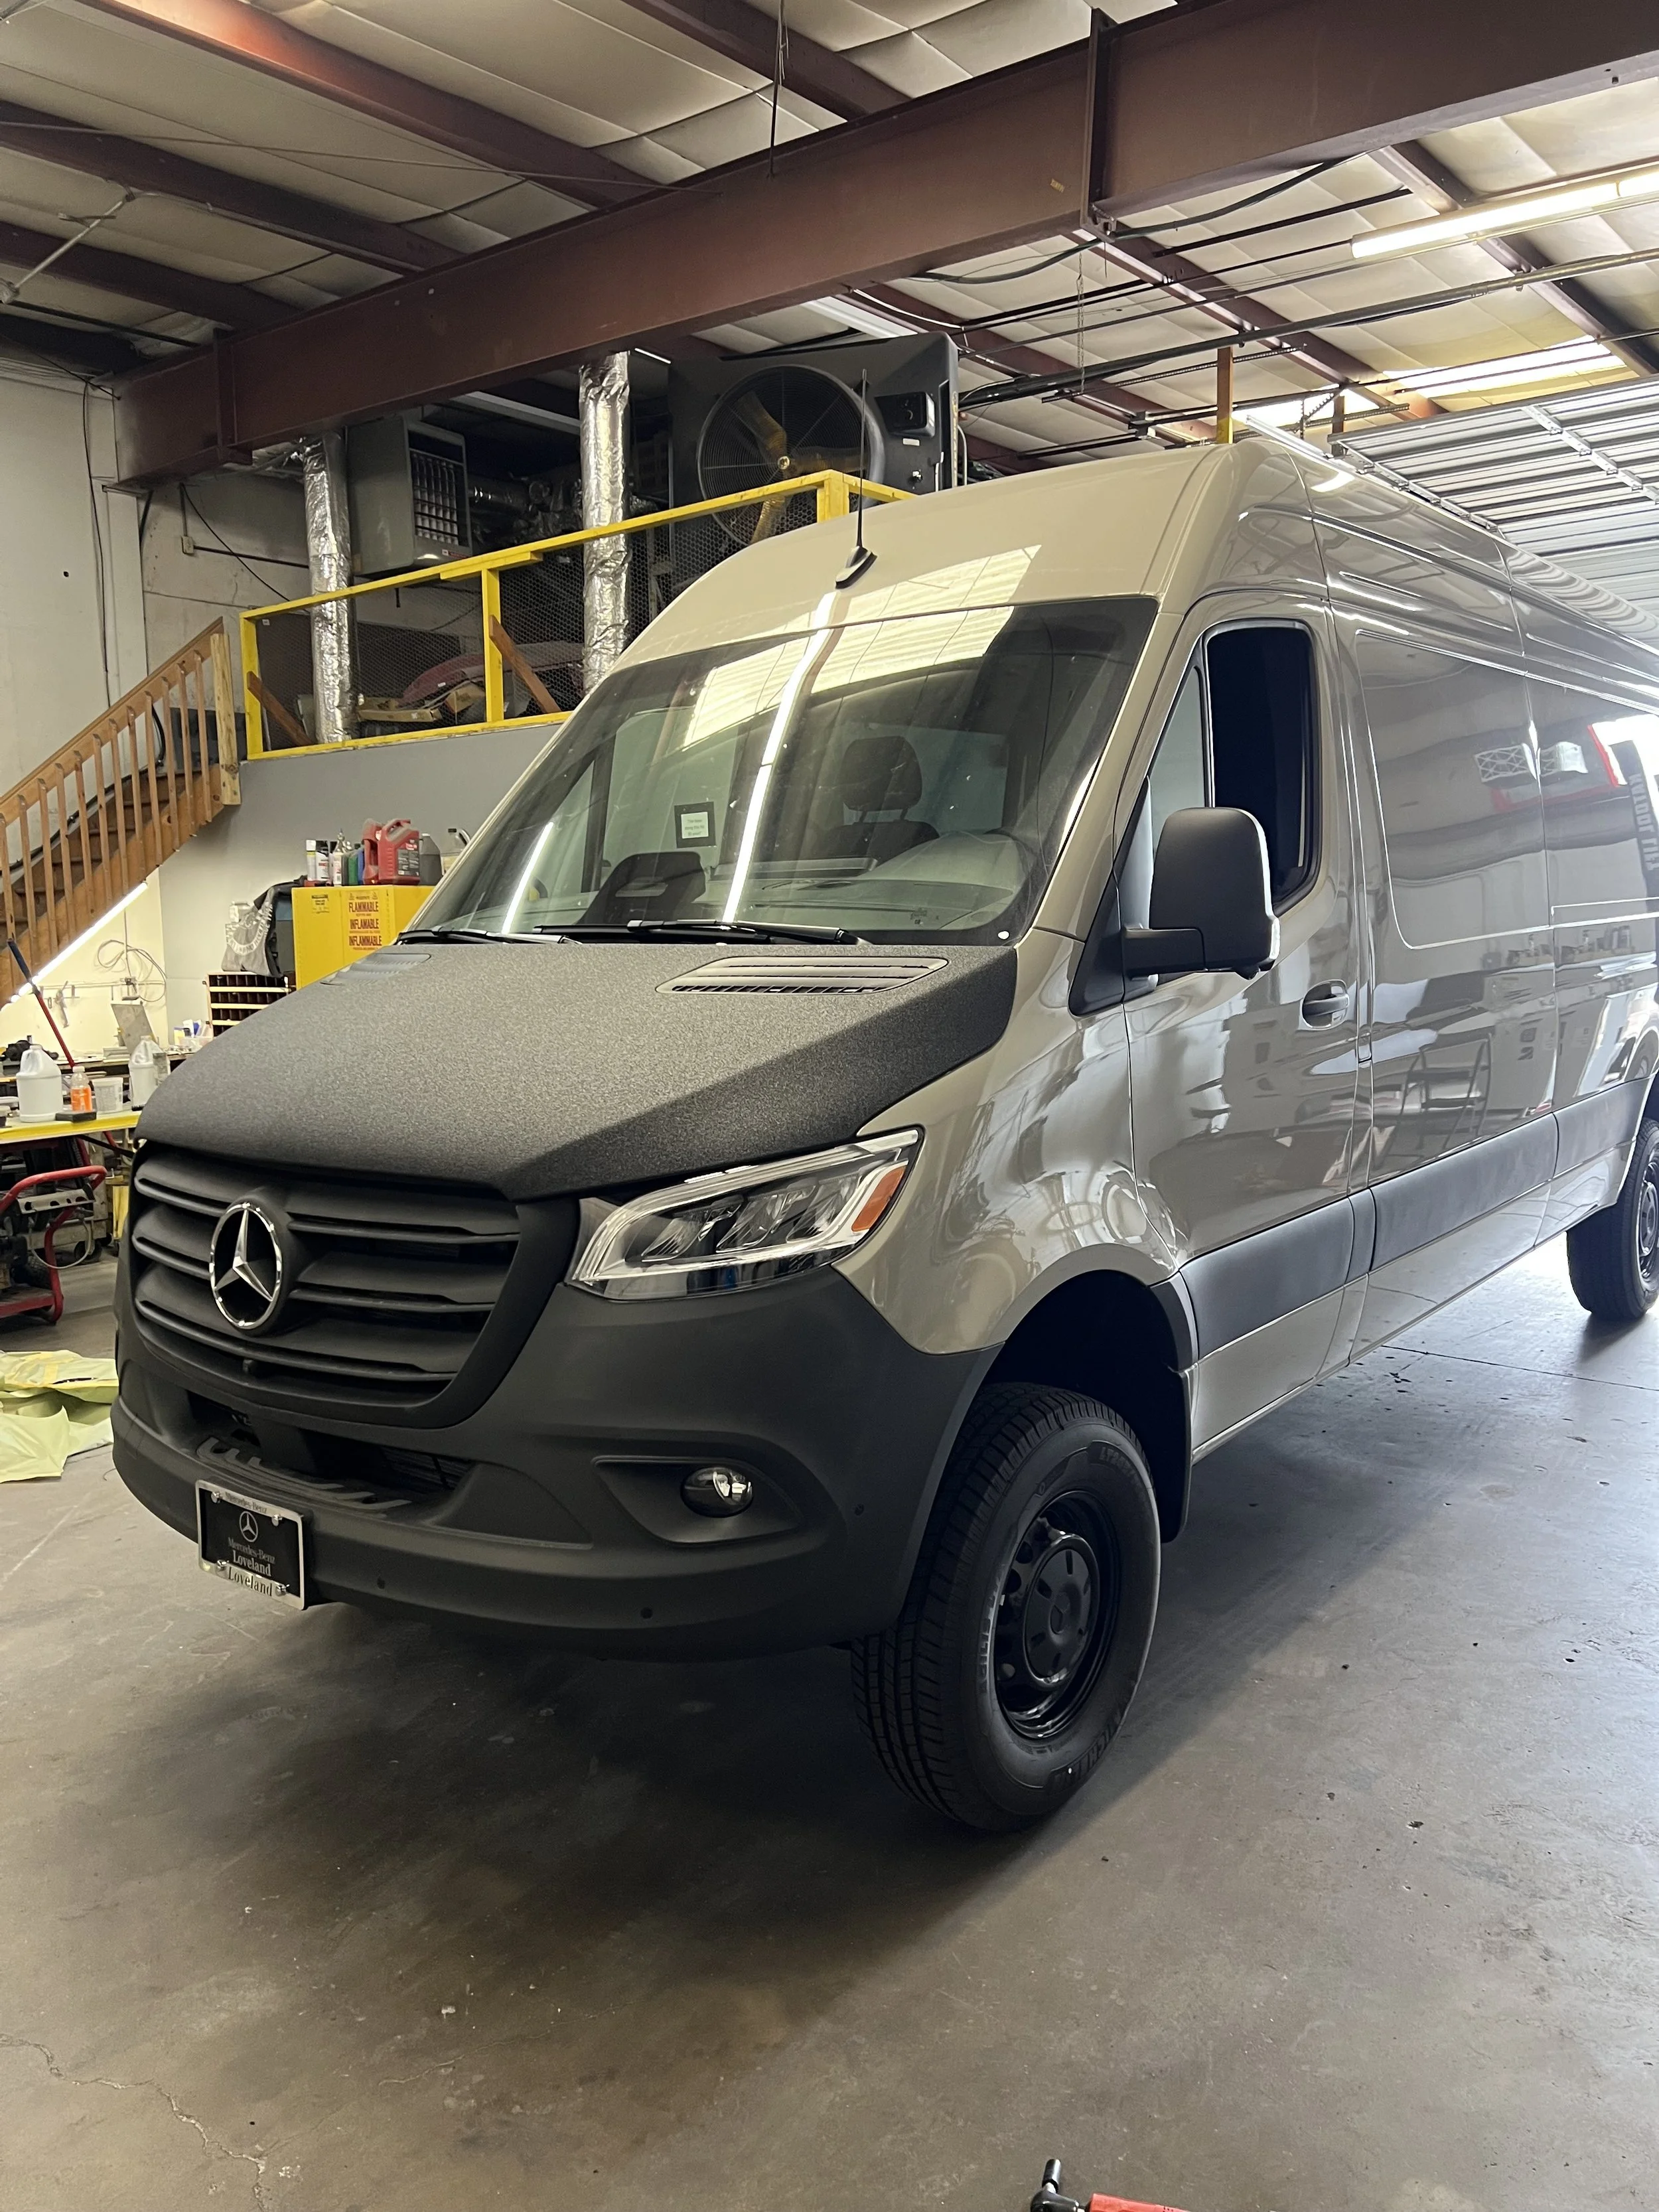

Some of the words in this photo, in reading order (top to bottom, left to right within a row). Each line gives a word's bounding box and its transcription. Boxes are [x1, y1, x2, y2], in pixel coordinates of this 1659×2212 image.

[348, 901, 379, 913] FLAMMABLE
[228, 1536, 275, 1565] Mercedes-Benz
[232, 1550, 271, 1577] Loveland
[228, 1566, 273, 1597] Loveland
